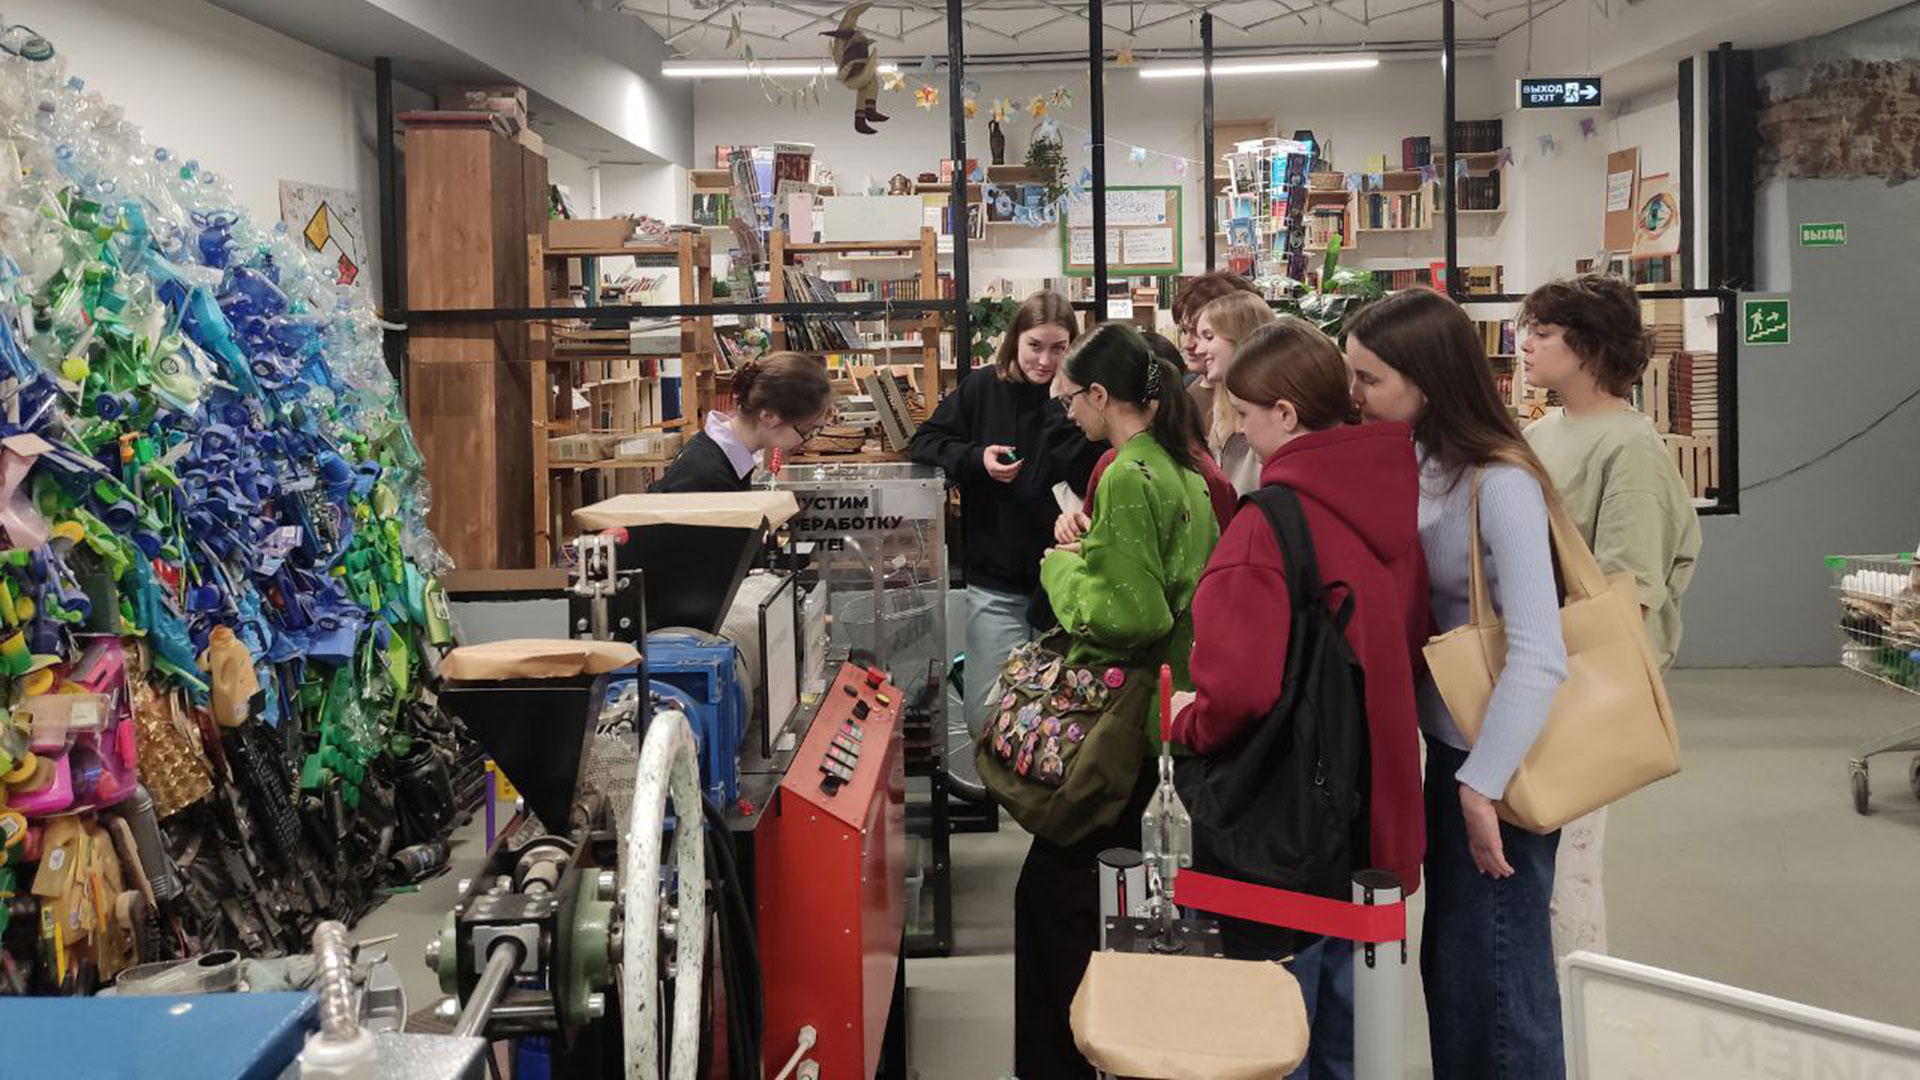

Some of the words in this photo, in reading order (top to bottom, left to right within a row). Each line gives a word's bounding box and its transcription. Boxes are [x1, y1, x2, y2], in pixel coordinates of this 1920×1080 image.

[1523, 84, 1563, 94] ВЫХОД
[1531, 94, 1556, 103] EXIT
[1803, 228, 1844, 242] ВЫХОД
[797, 496, 869, 510] УСТИМ
